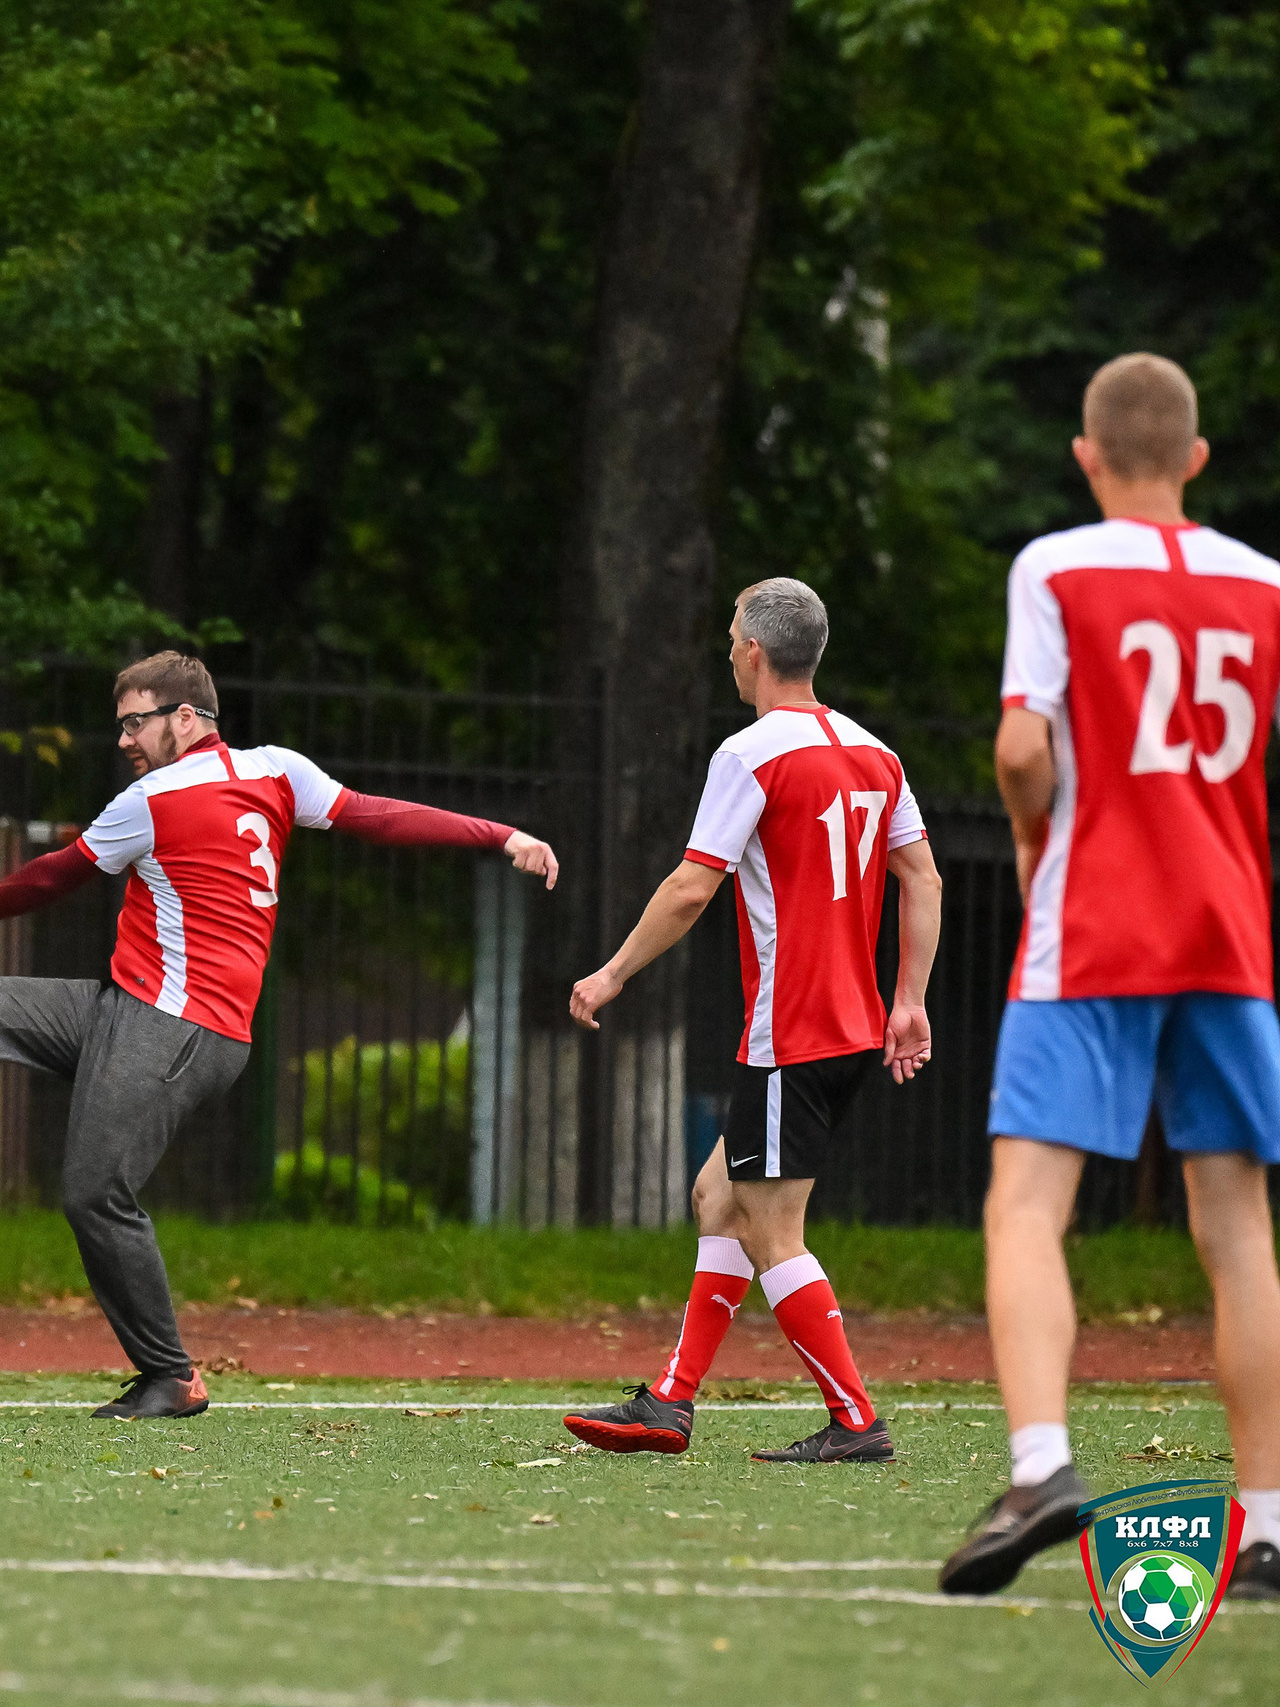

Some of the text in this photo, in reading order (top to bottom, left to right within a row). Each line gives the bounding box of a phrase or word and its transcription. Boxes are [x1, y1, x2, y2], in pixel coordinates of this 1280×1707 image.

[1120, 619, 1257, 784] 25
[236, 811, 279, 908] 3
[816, 788, 888, 902] 17
